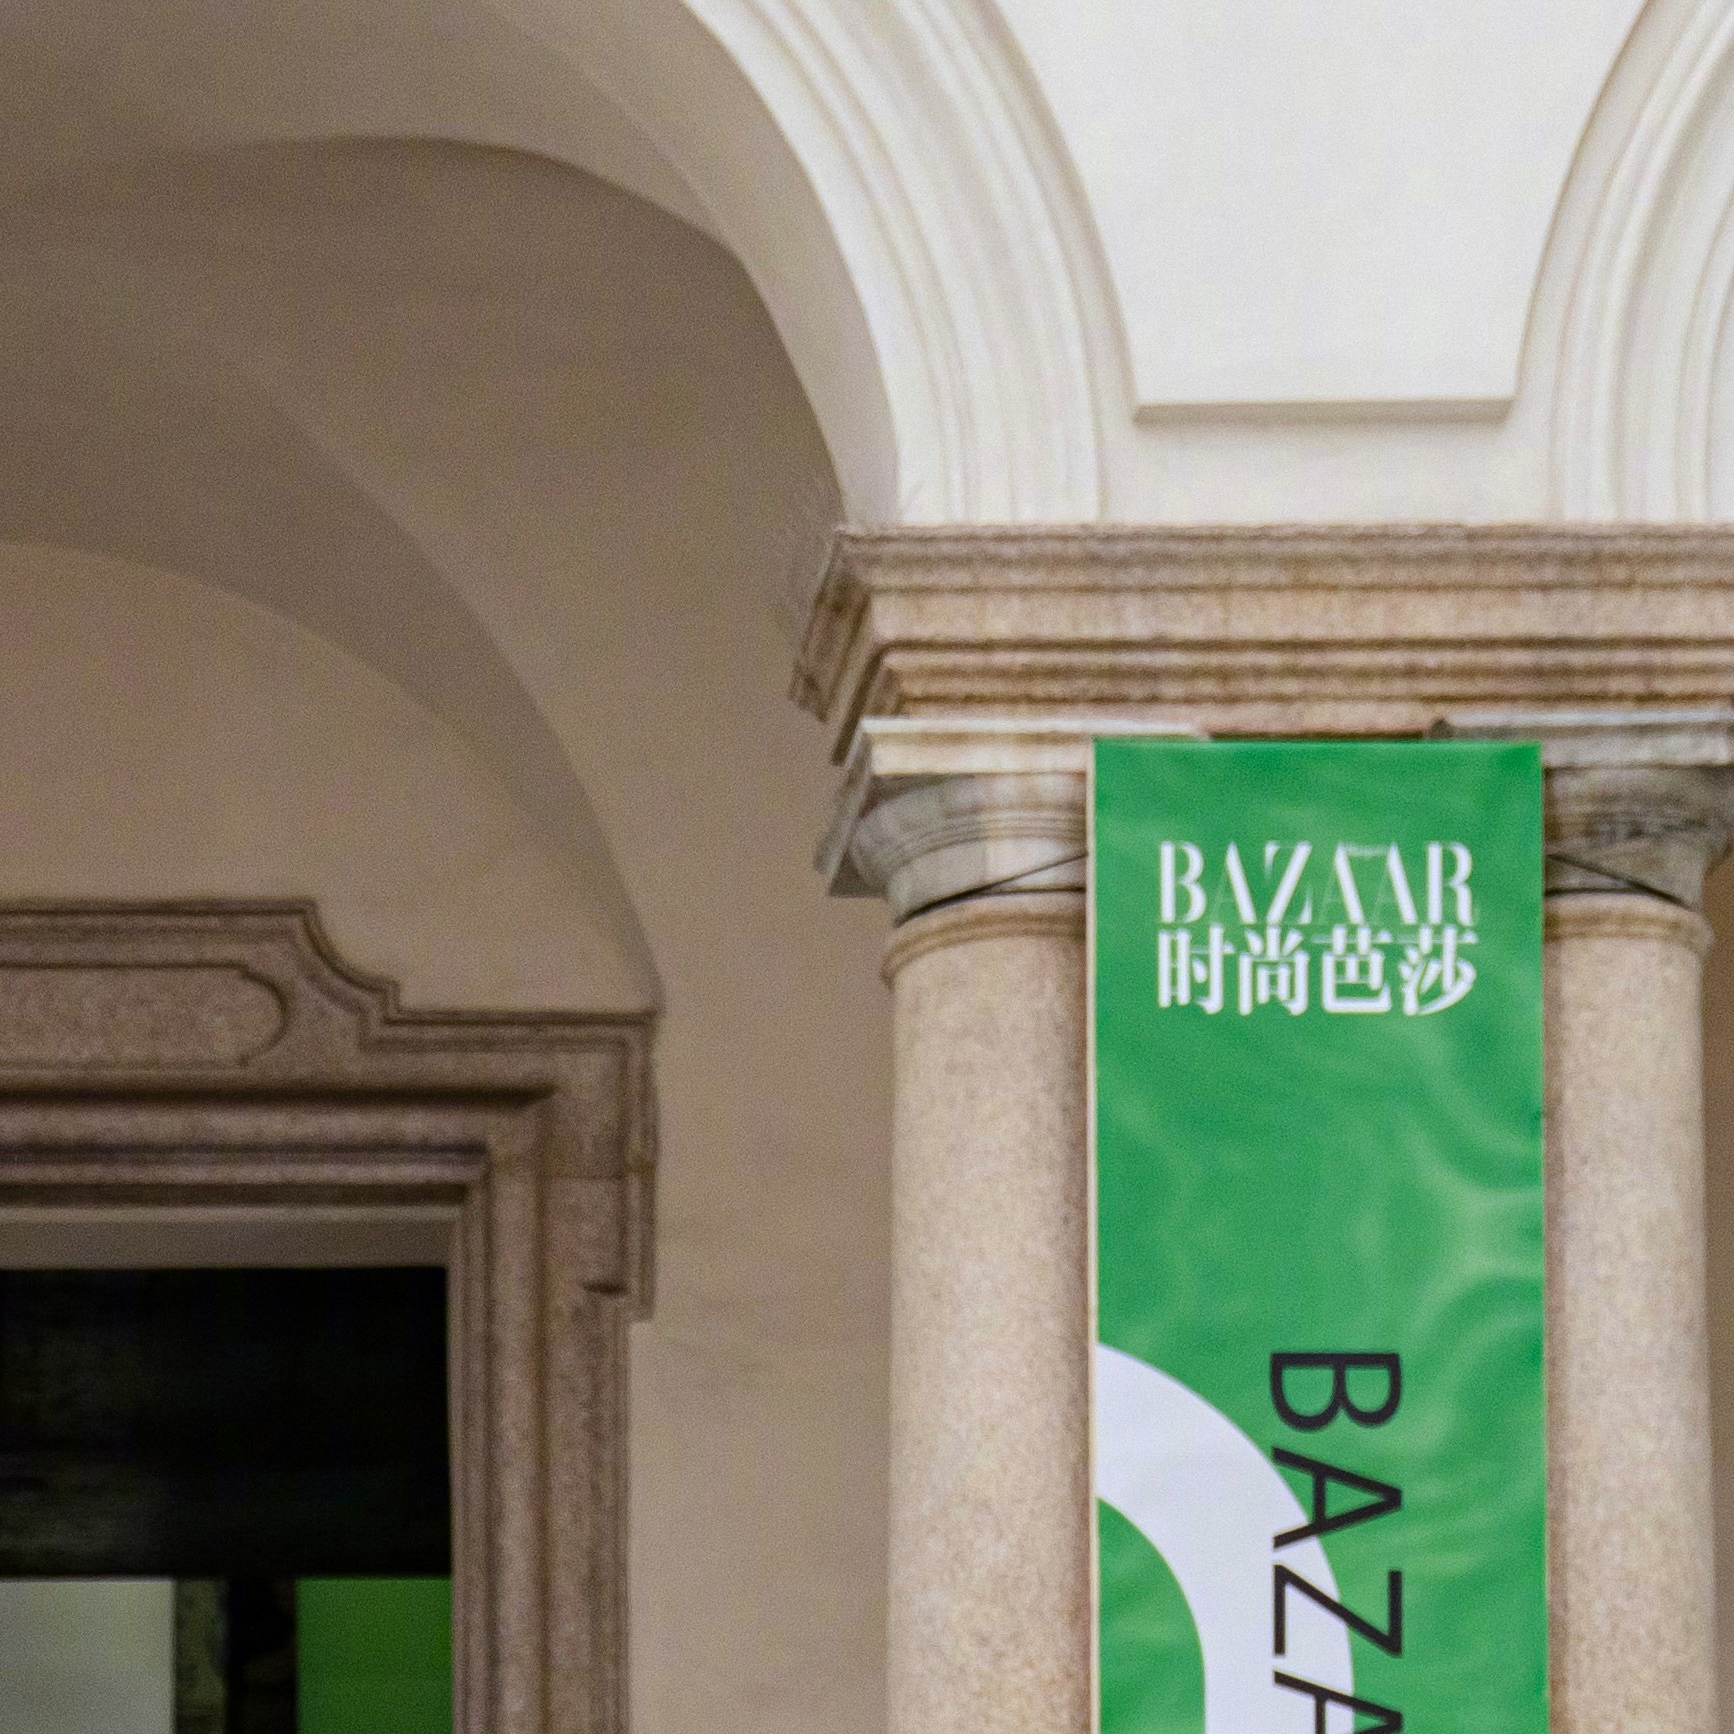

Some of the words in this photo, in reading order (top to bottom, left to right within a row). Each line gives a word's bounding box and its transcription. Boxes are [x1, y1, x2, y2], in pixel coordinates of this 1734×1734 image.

[1158, 841, 1478, 926] BAZAAR
[1158, 923, 1478, 1016] 时尚芭莎
